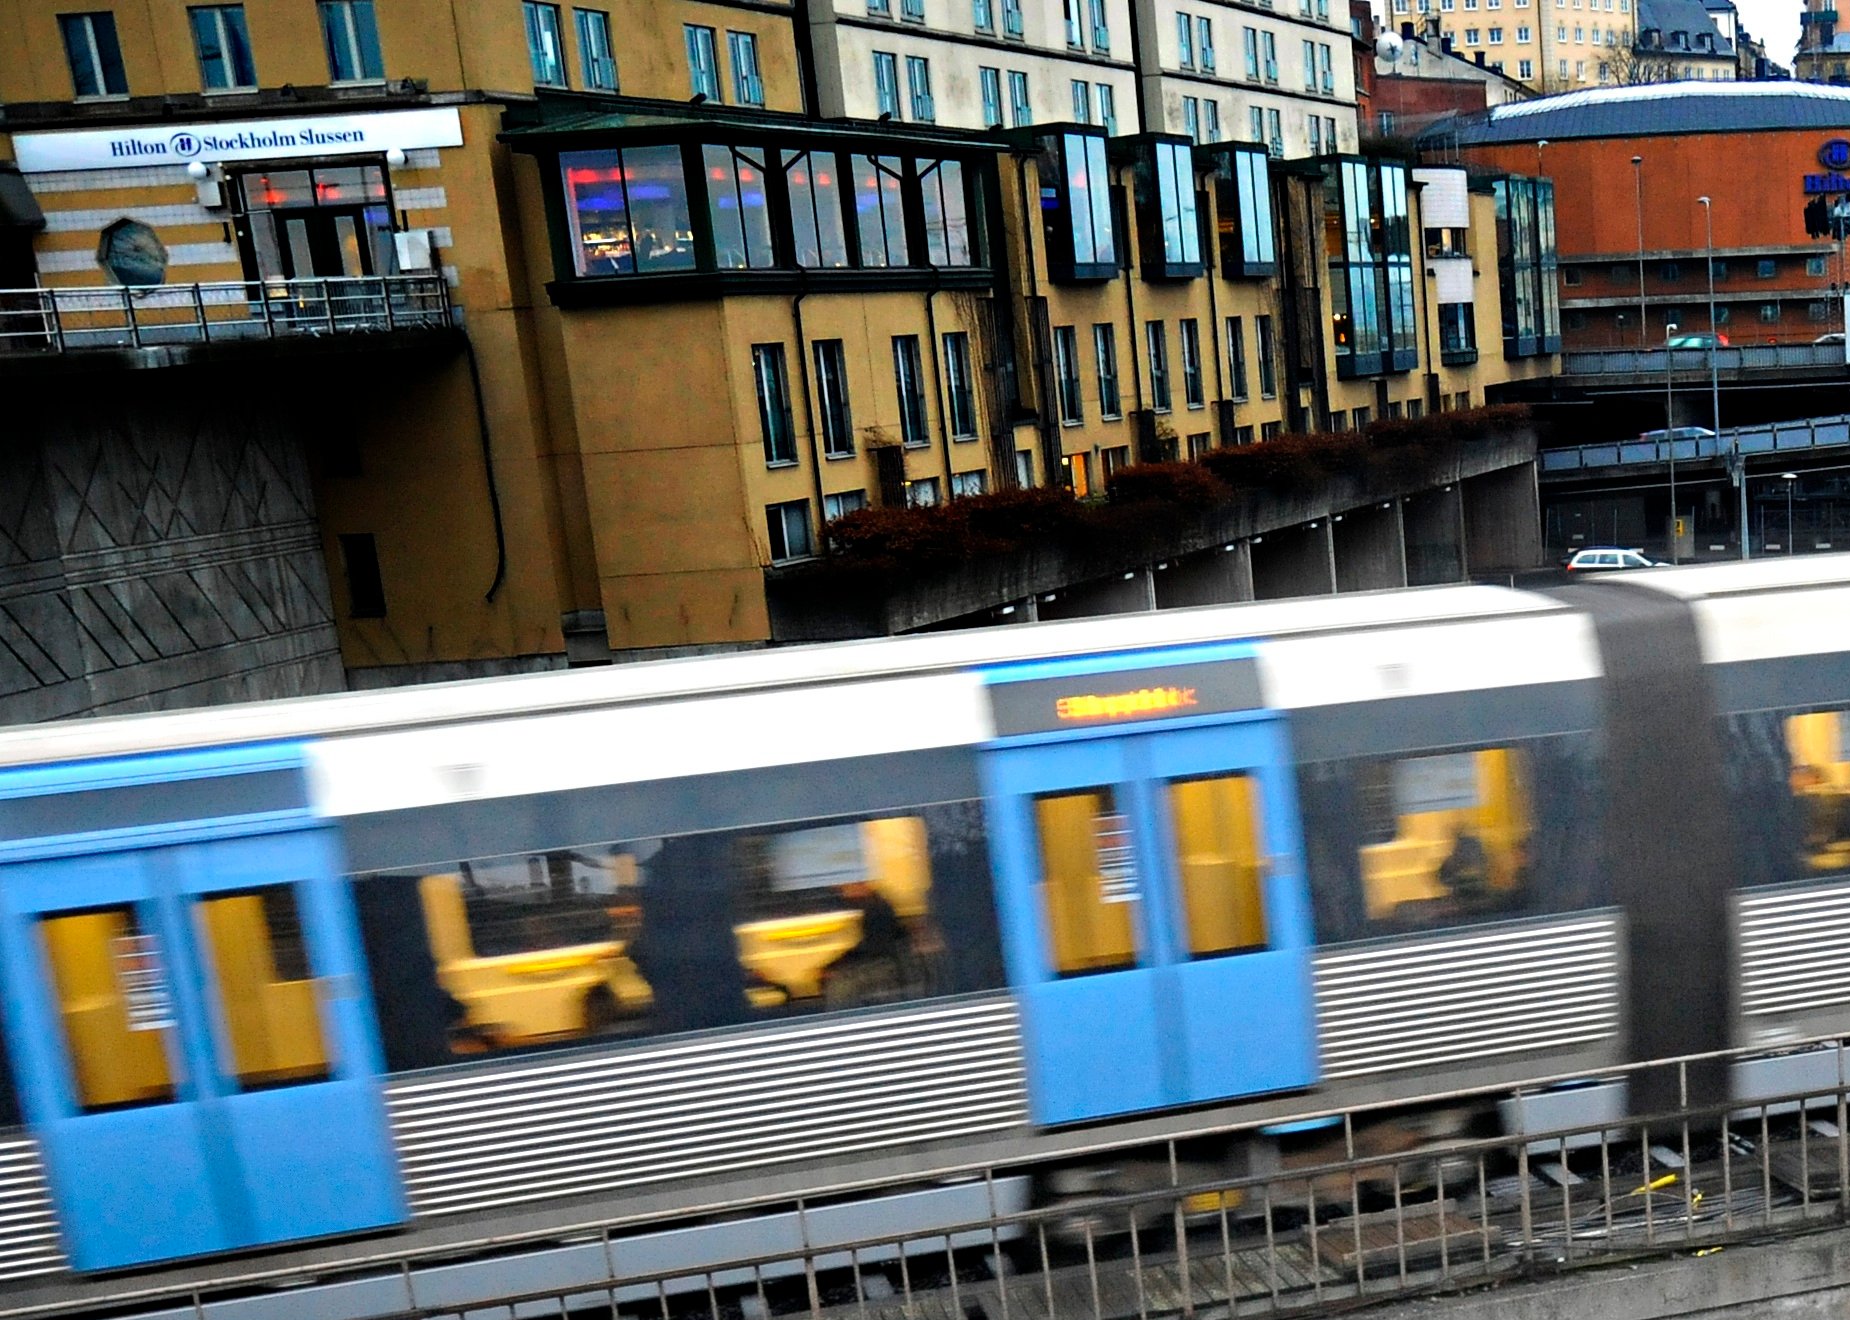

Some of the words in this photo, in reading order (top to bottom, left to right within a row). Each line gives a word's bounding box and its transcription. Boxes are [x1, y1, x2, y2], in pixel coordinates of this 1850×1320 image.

[111, 139, 167, 157] Hilton
[203, 131, 296, 150] Stockholm
[300, 128, 364, 147] Slussen
